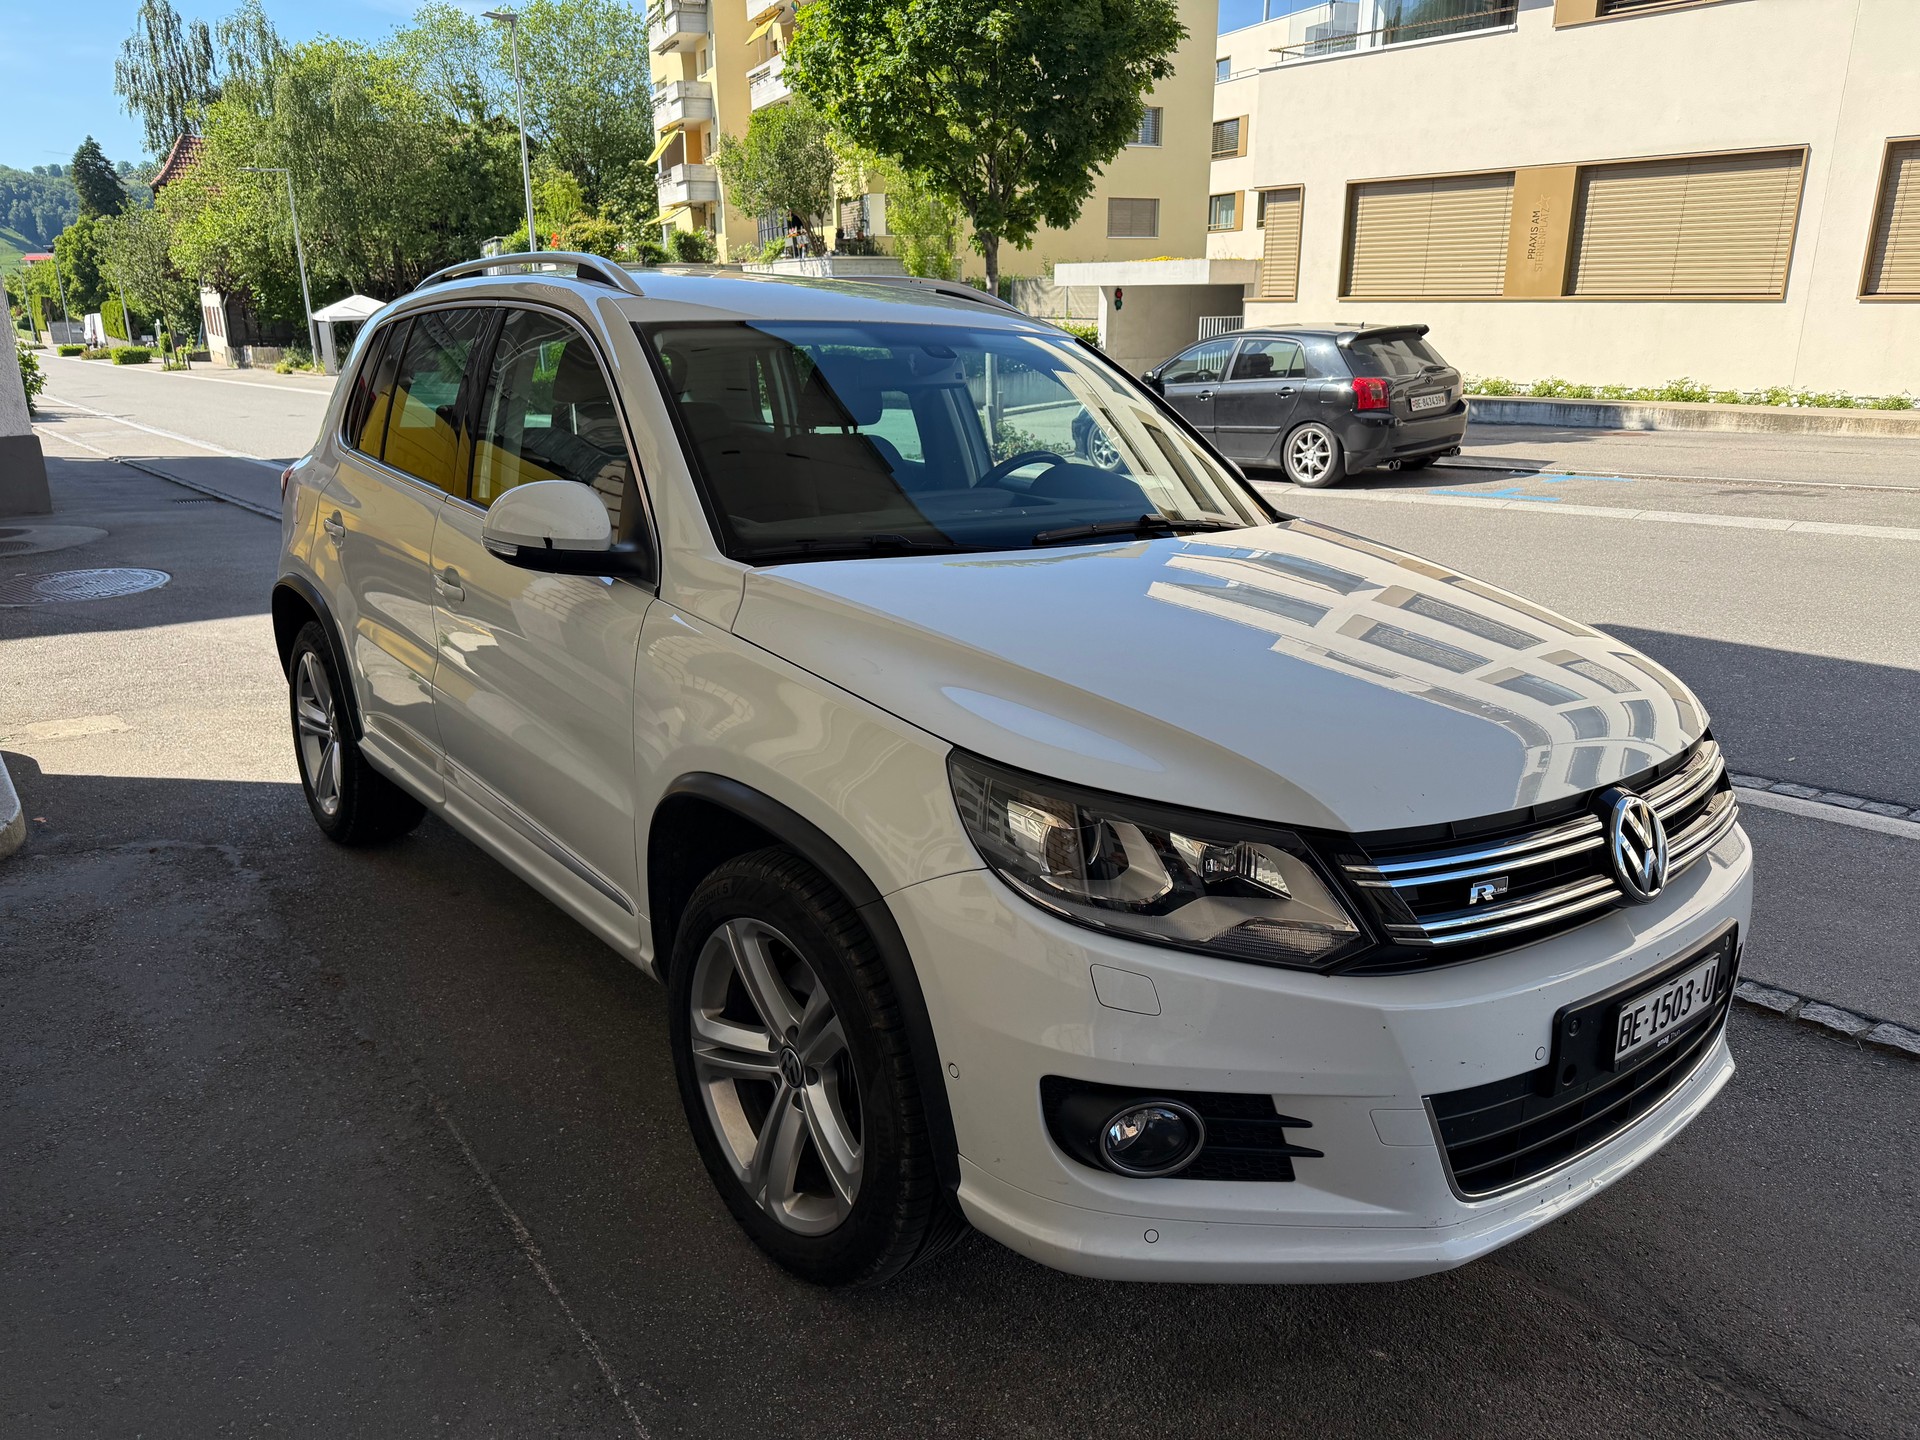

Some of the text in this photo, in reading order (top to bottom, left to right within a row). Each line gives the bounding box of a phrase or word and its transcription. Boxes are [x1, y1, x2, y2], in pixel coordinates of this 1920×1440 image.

[1527, 210, 1541, 260] PRAXIS AM
[1534, 207, 1550, 272] STERNENPLATZ
[1469, 884, 1495, 905] R
